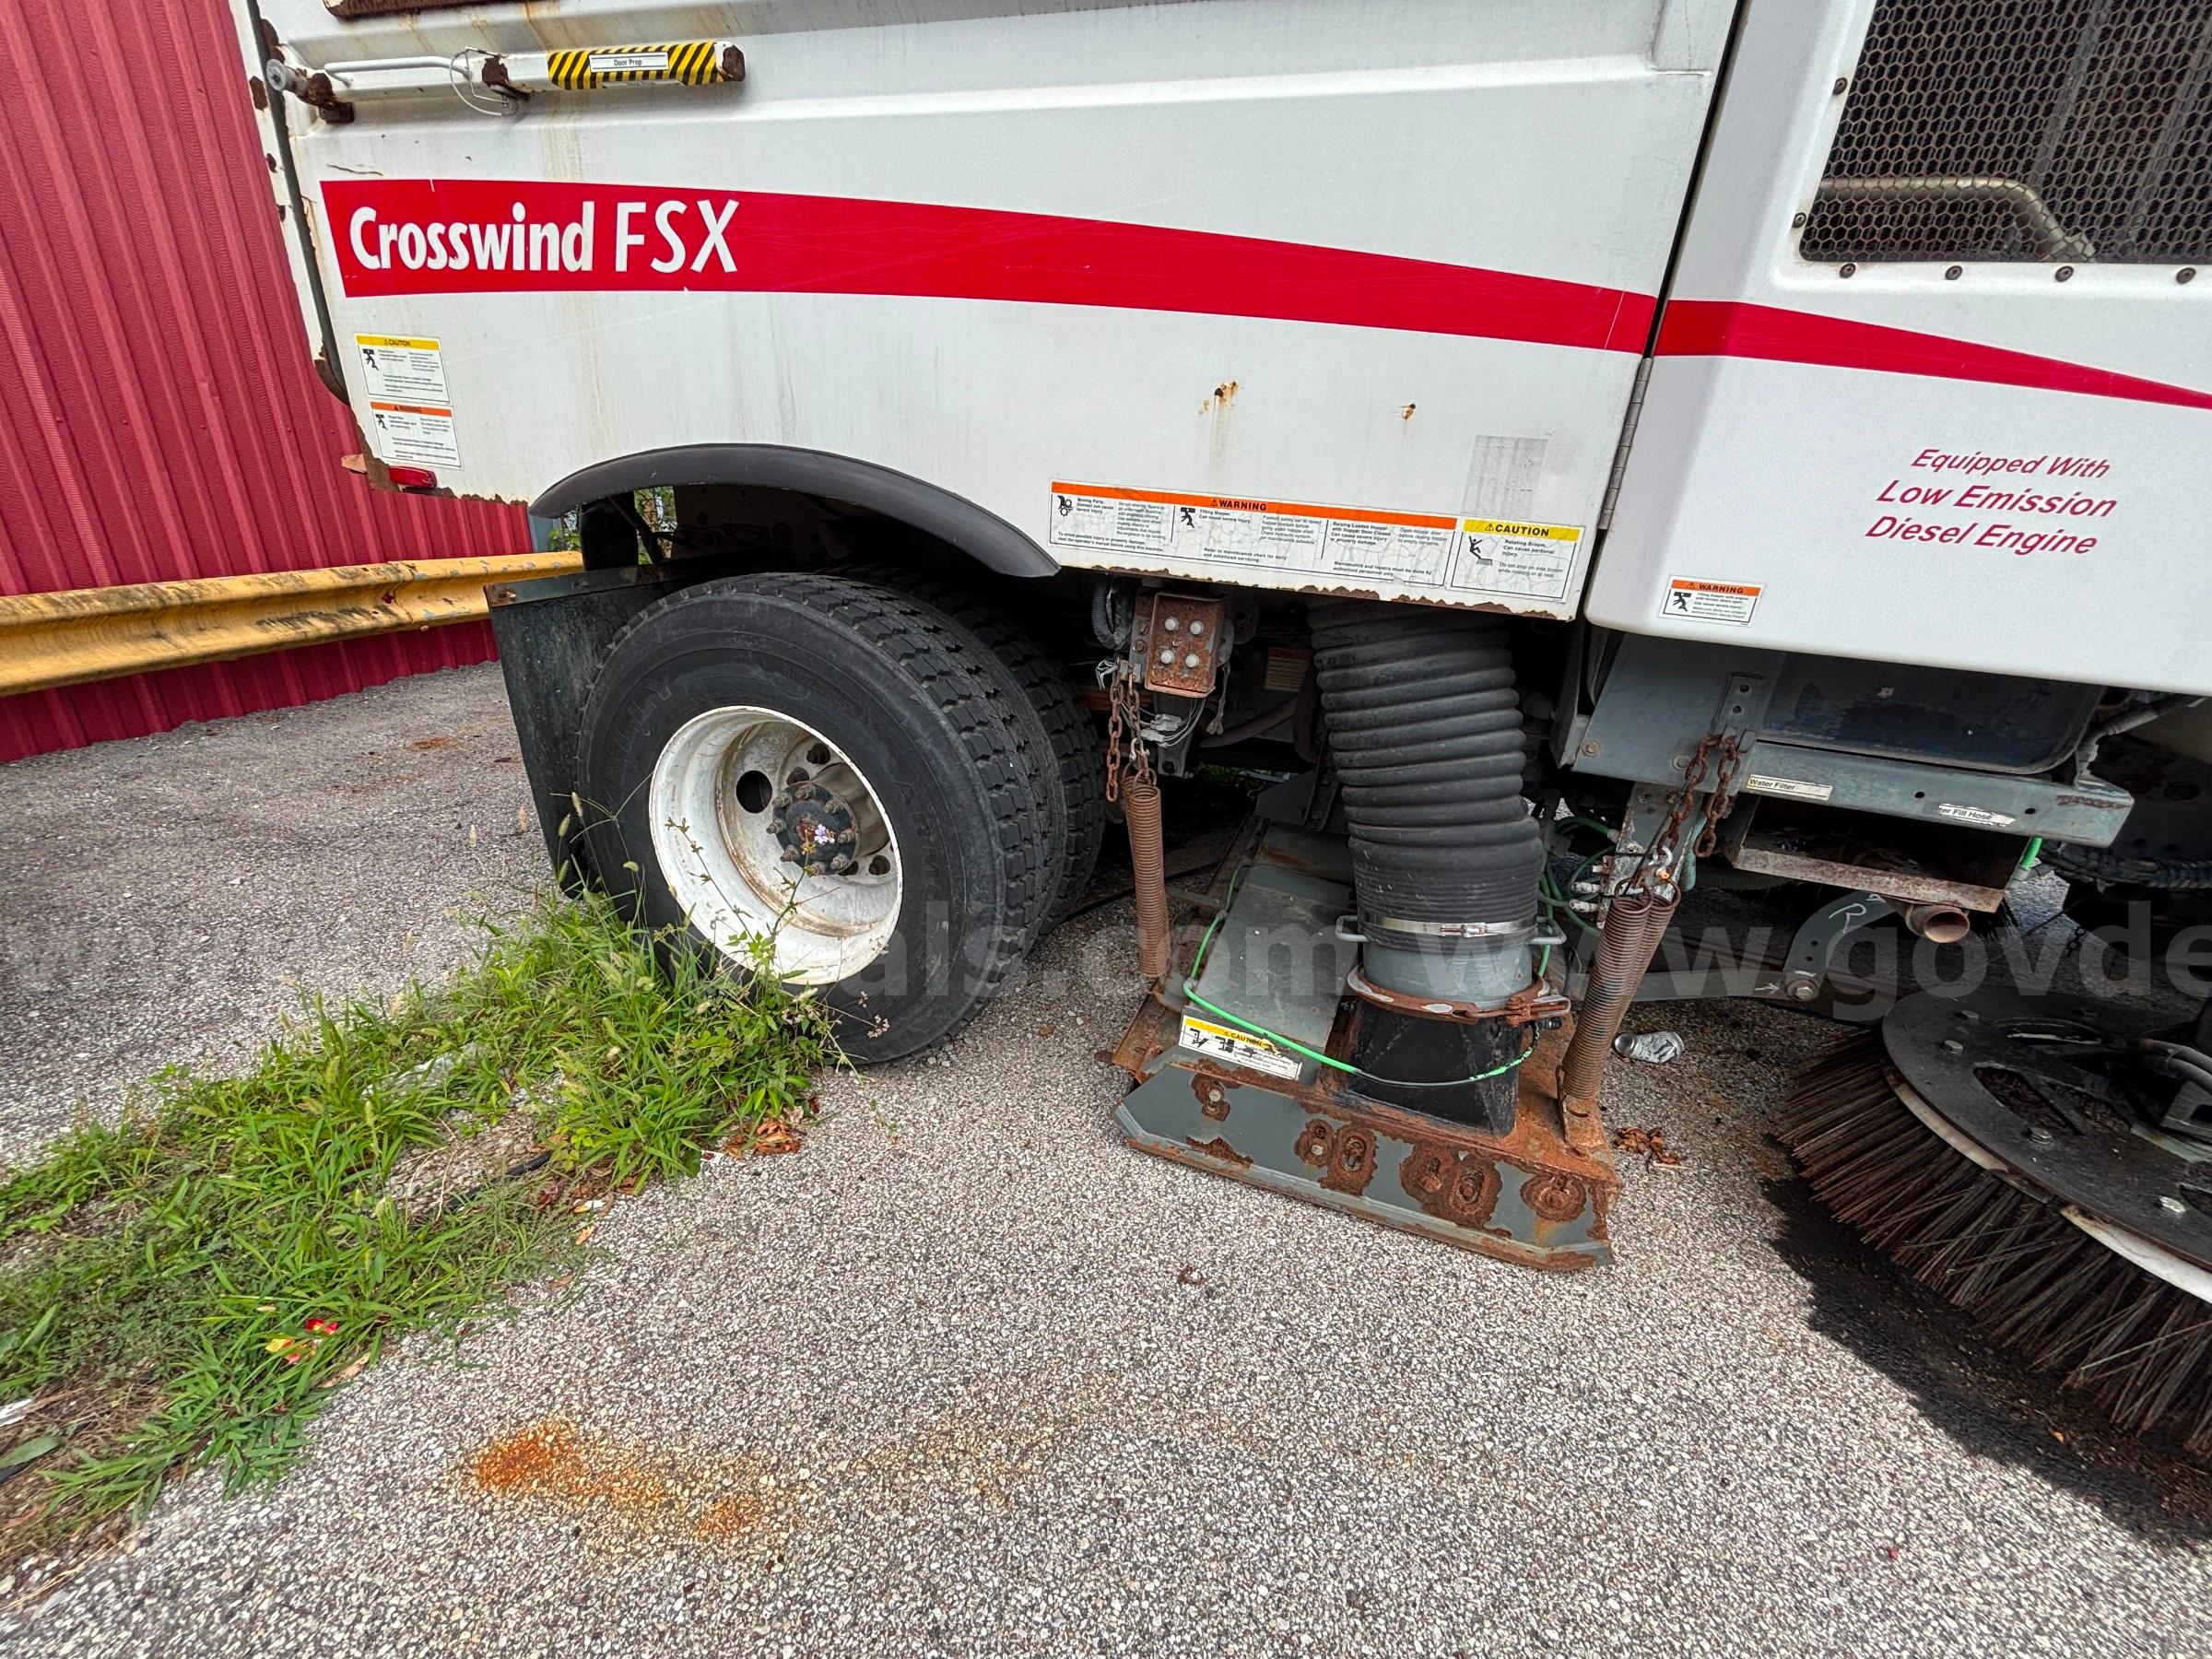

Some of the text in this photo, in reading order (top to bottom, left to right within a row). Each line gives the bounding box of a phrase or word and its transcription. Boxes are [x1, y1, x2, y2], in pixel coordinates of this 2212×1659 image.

[629, 58, 642, 66] Prop
[349, 199, 739, 274] Crosswind FSX
[1911, 449, 2111, 478] Equipped With
[1876, 479, 2118, 517] Low Emission
[1219, 500, 1266, 511] WARNING
[1495, 524, 1549, 535] CAUTION
[1865, 515, 2098, 556] Diesel Engine
[1699, 582, 1744, 594] WARNING
[1749, 778, 1795, 791] Water Filter
[1952, 808, 1967, 817] Fill
[1969, 811, 1992, 820] Hose
